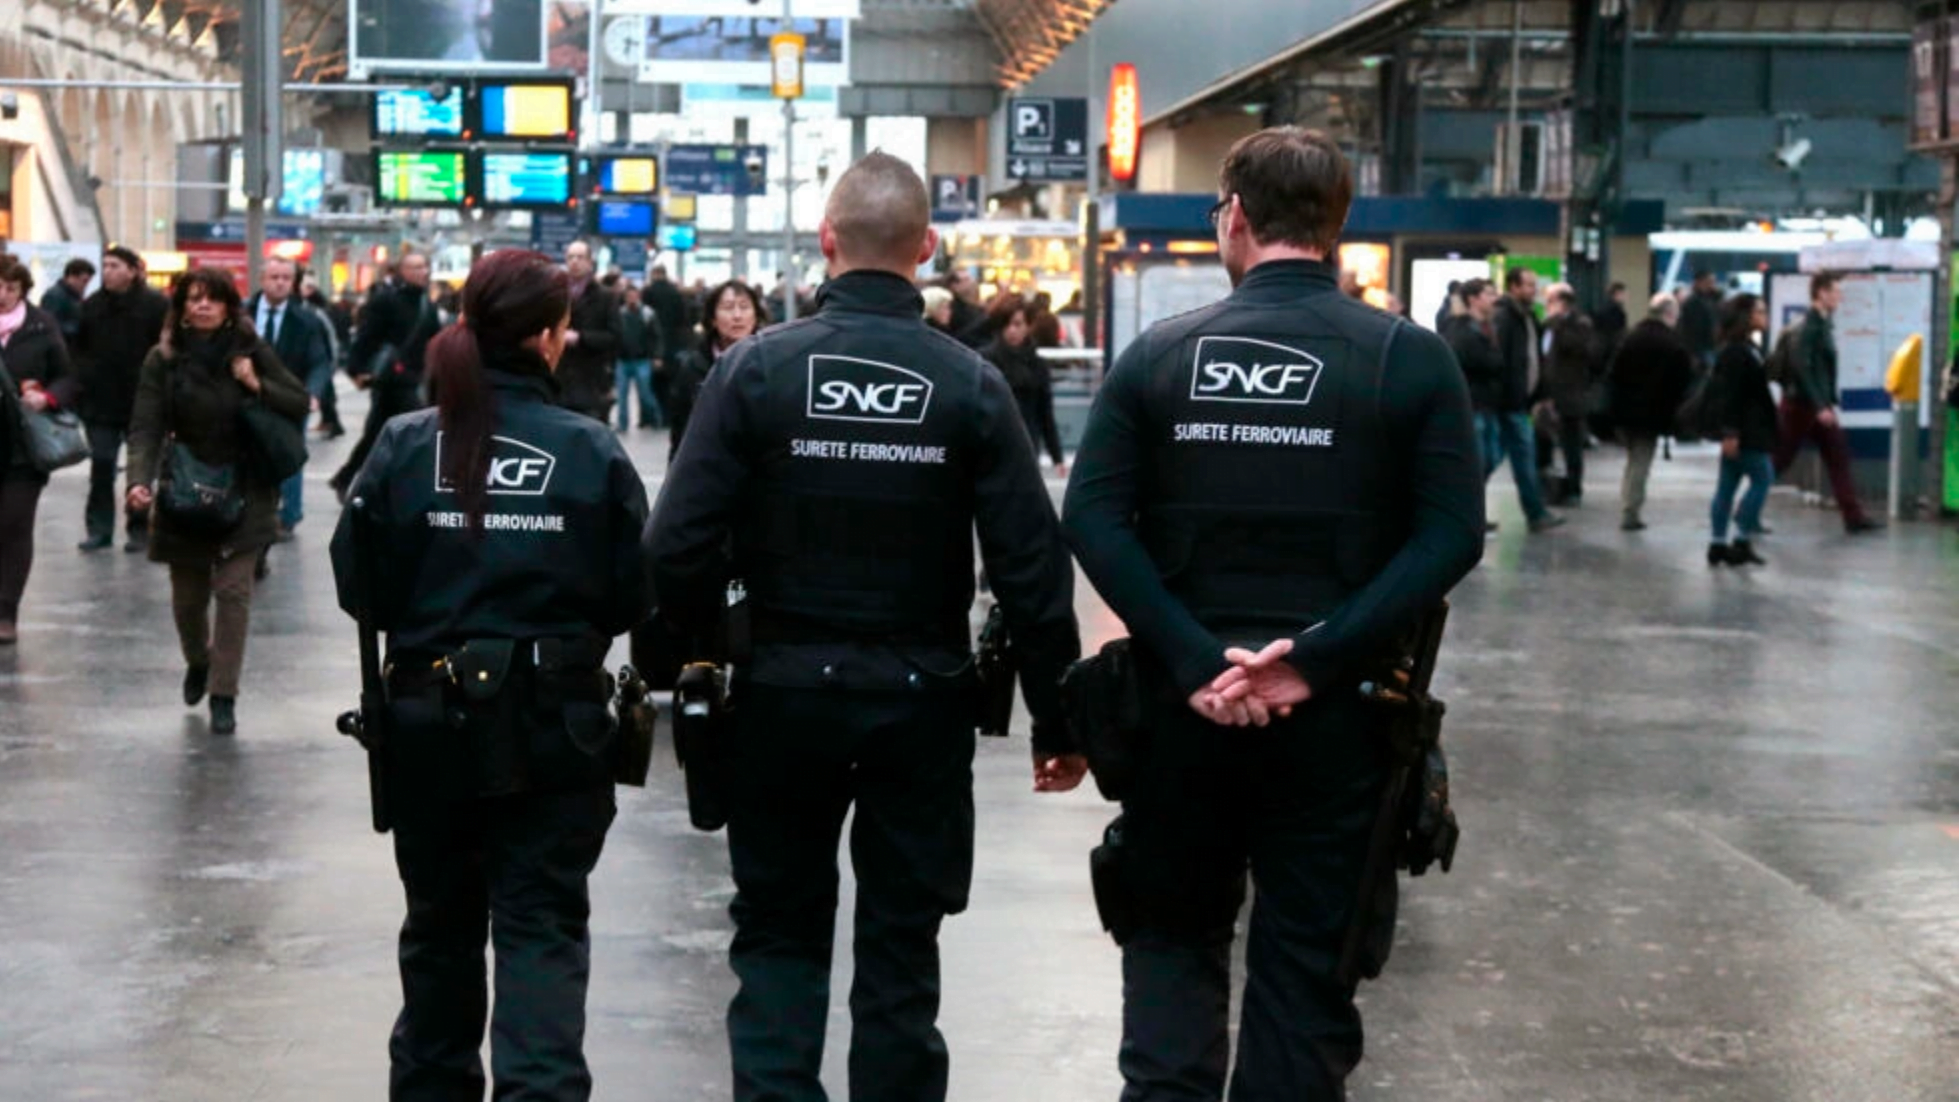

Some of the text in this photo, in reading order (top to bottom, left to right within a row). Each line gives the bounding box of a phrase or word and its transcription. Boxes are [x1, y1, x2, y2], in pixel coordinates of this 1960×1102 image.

[1198, 361, 1313, 394] SNCF
[814, 380, 924, 414] SNCF
[1174, 422, 1334, 446] SURETE FERROVIAIRE
[791, 439, 946, 463] SURETE FERROVIAIRE
[427, 511, 565, 532] URET ERROVIAIRE
